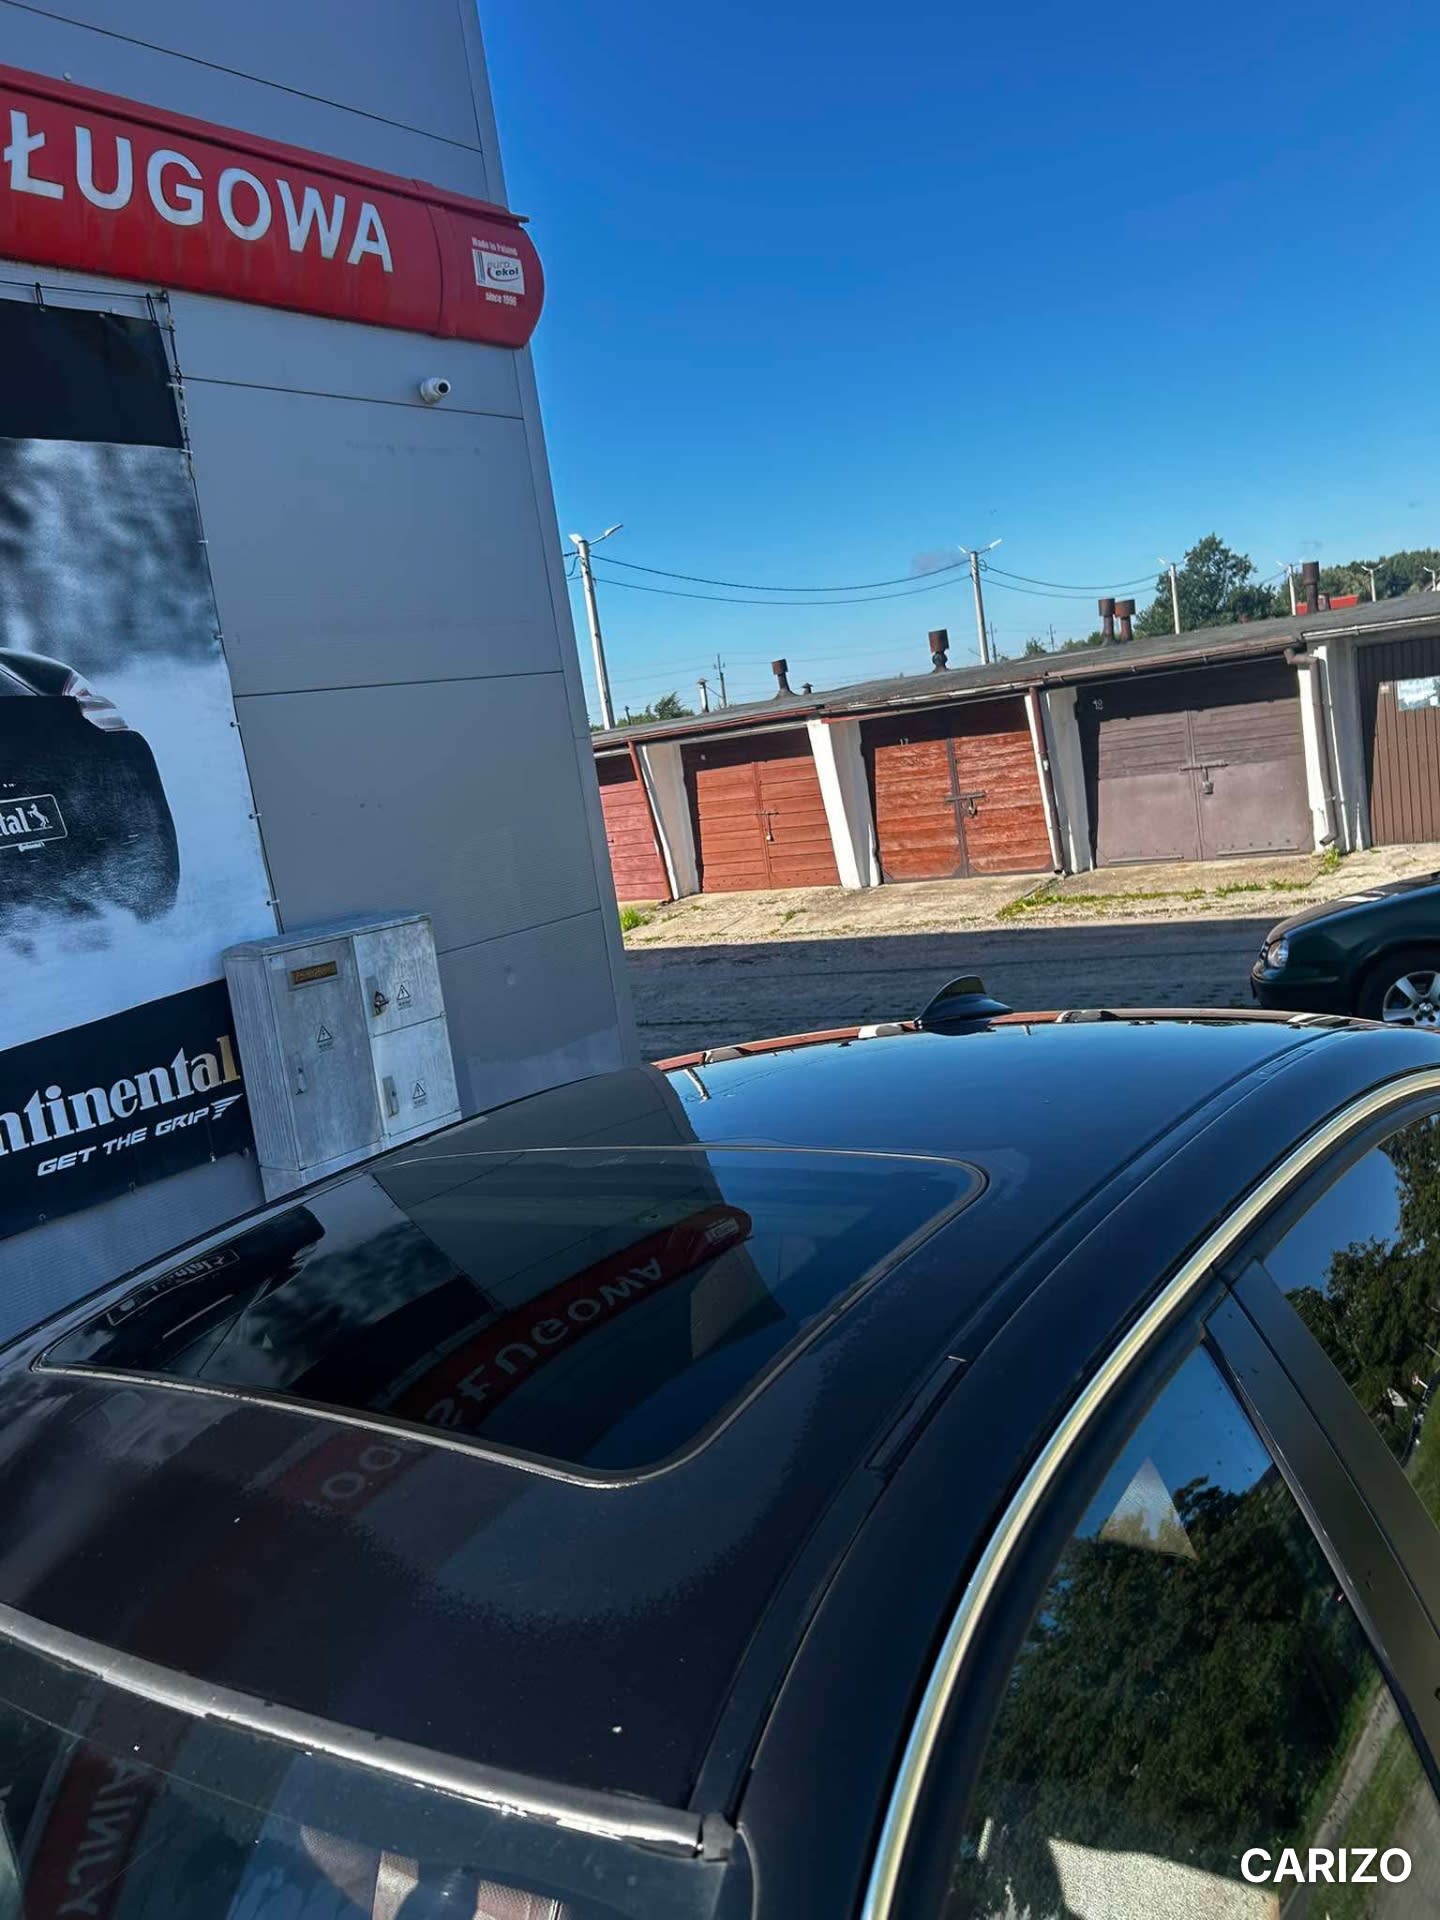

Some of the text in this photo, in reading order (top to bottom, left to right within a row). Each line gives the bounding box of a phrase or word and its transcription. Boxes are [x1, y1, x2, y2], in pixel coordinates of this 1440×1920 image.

[3, 109, 394, 273] ŁUGOWA
[0, 807, 32, 836] tal
[37, 1107, 209, 1177] GET THE GRIP
